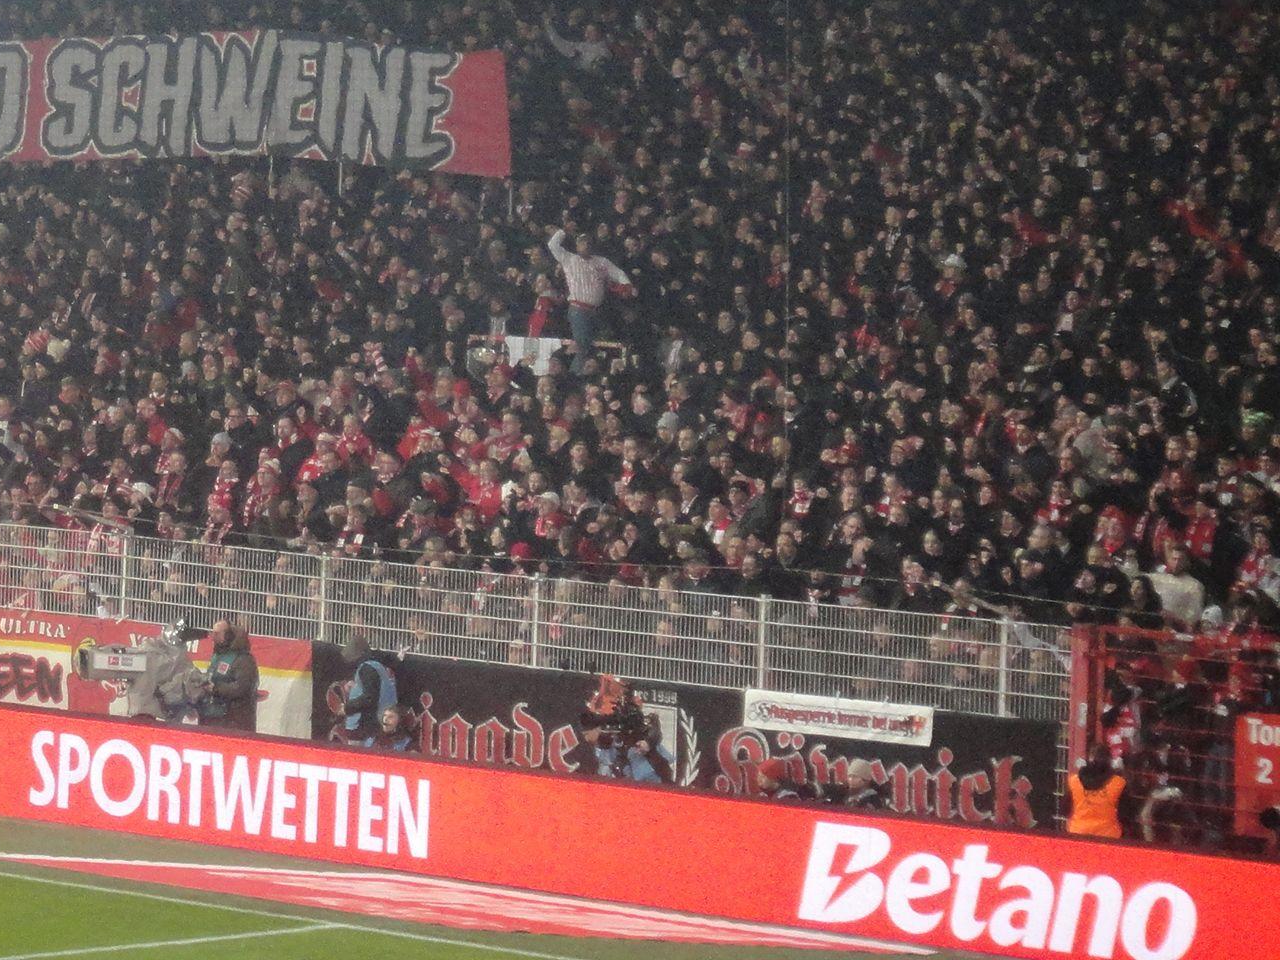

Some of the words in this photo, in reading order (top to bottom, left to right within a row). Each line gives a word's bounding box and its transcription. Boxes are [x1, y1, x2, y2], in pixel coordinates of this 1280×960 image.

[46, 30, 453, 164] SCHWEINE
[29, 730, 431, 860] SPORTWETTEN
[1256, 757, 1273, 784] 2
[798, 821, 1198, 960] Betano
